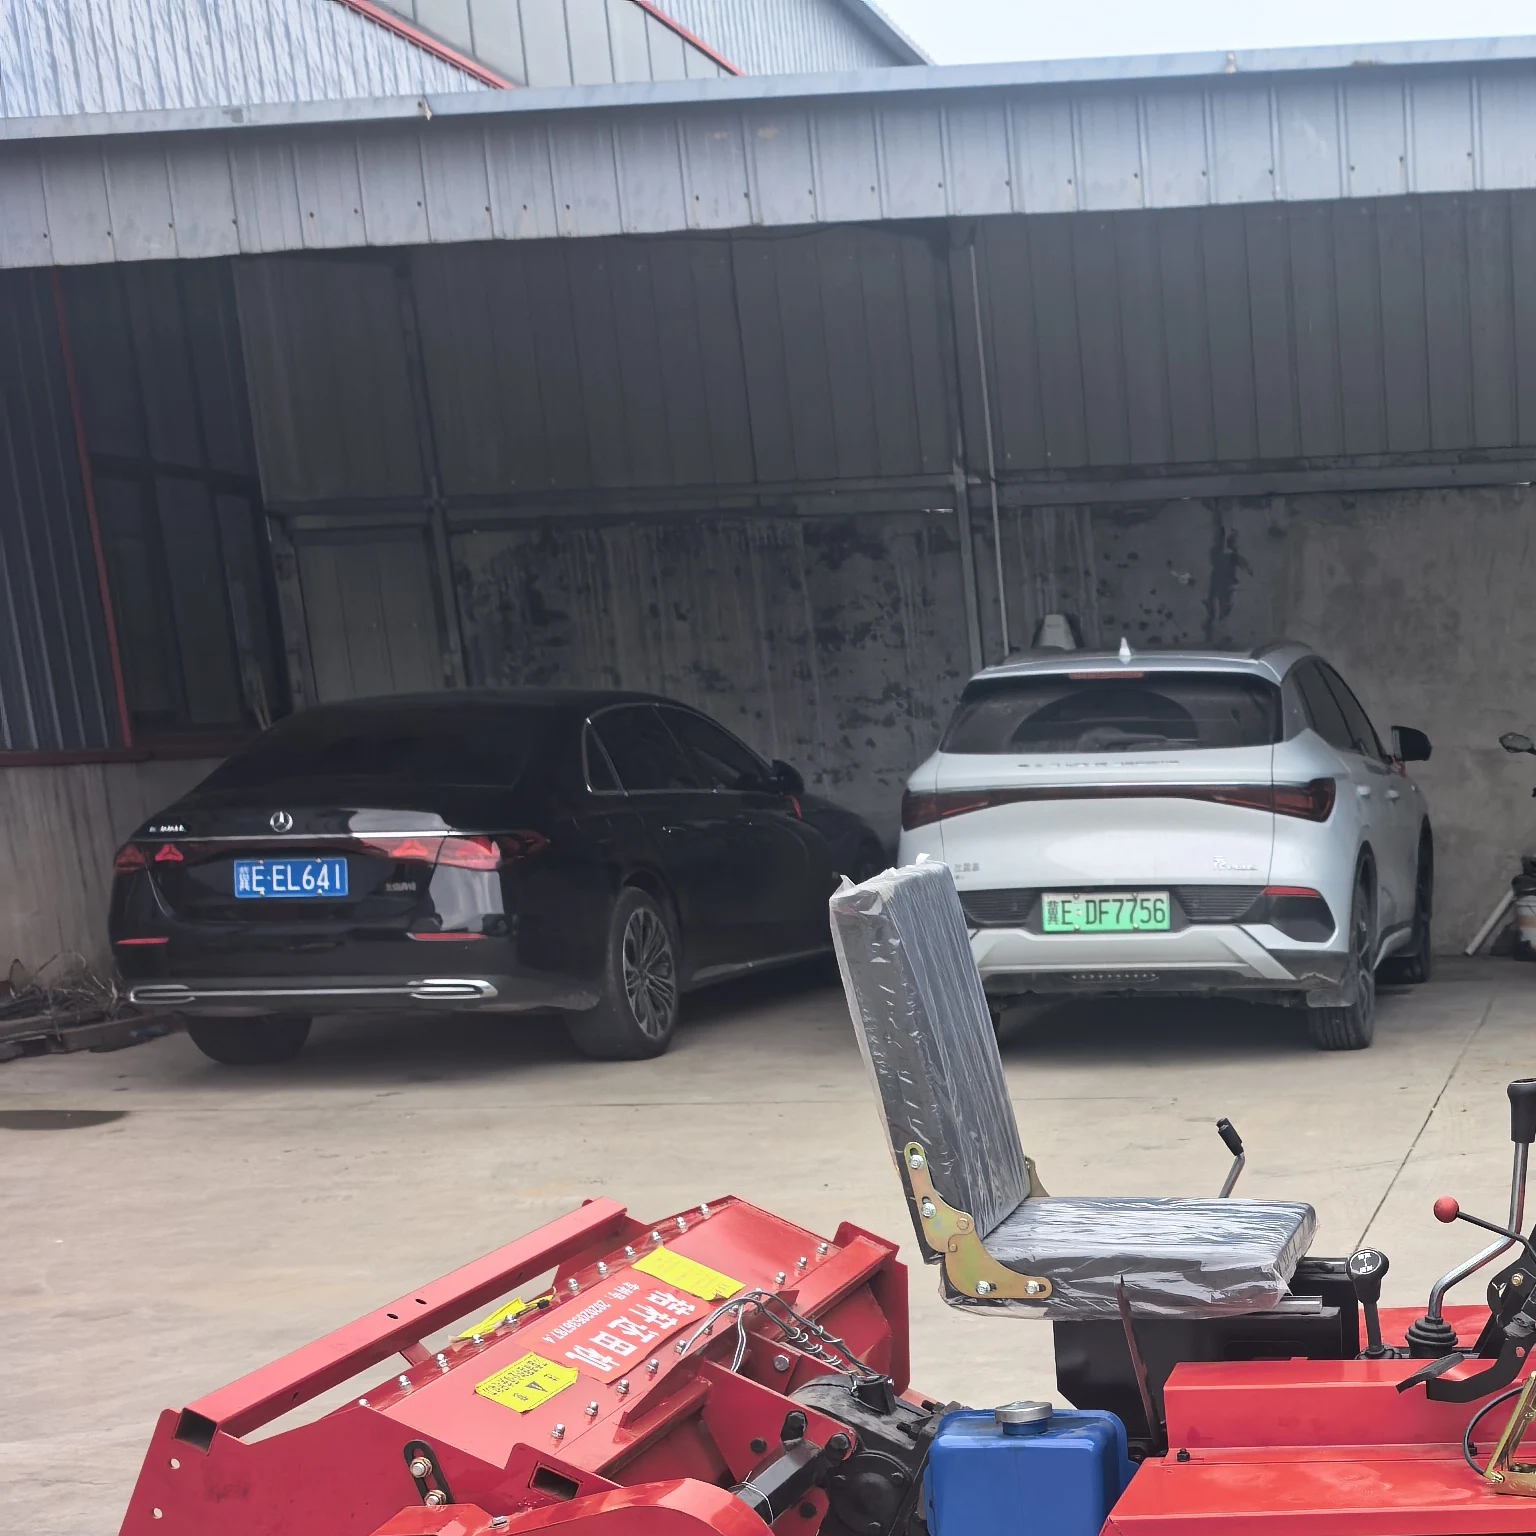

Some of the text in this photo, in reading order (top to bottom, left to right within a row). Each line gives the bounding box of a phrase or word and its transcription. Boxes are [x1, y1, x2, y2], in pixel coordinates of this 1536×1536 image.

[564, 1289, 696, 1373] 秸秆还田机
